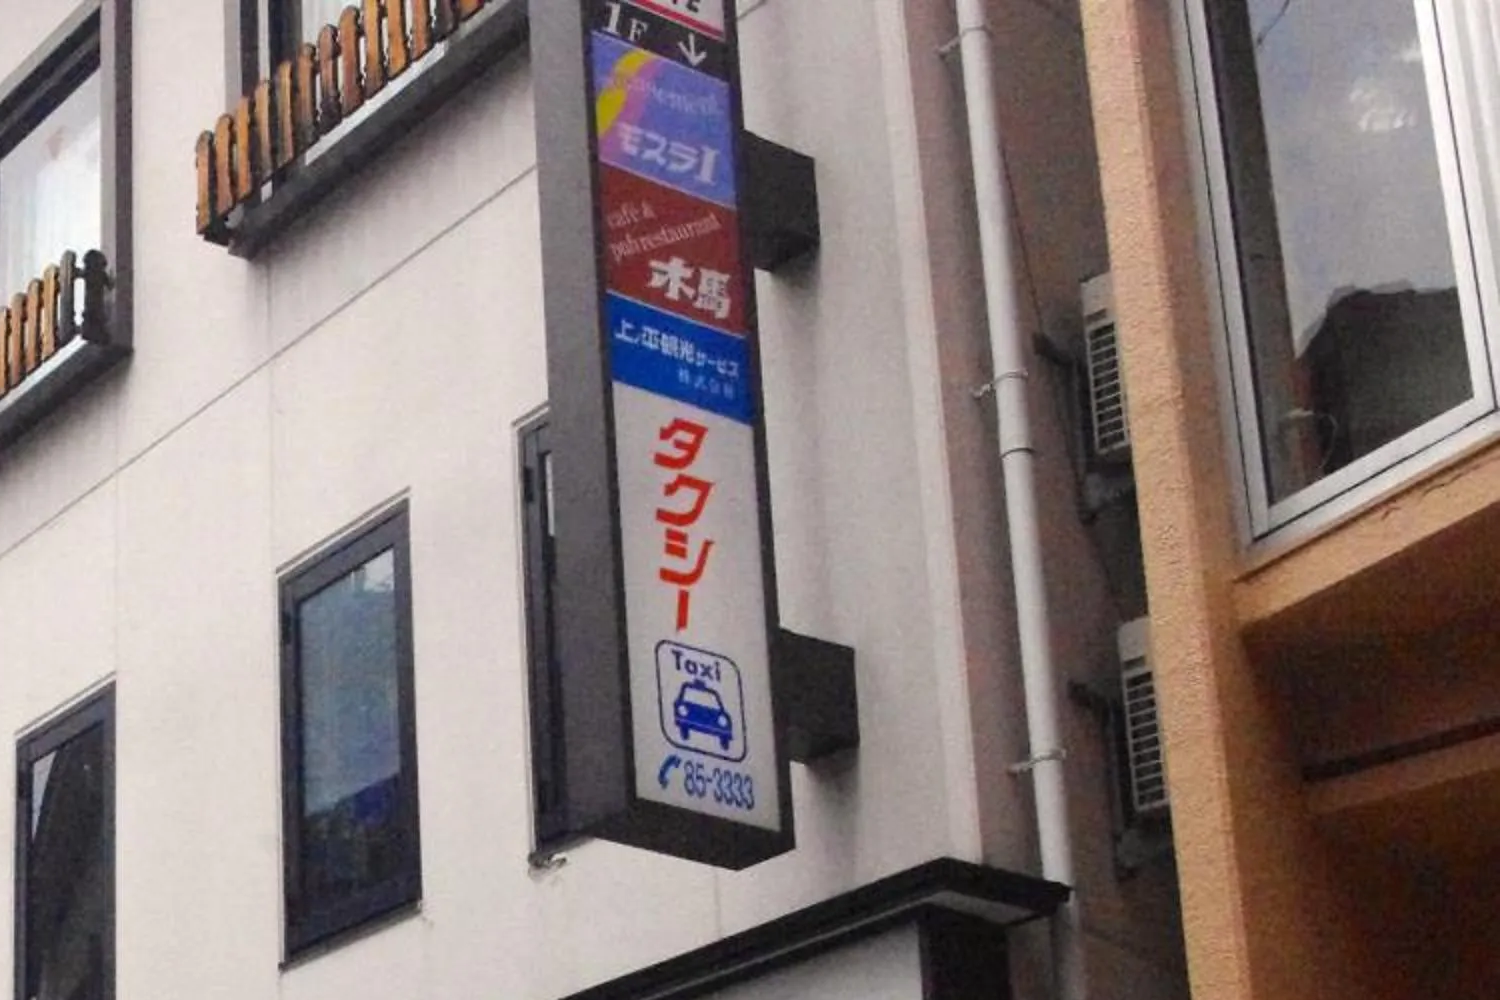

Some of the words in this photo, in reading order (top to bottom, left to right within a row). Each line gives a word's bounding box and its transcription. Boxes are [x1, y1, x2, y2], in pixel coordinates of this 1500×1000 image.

[646, 256, 730, 319] 木馬
[653, 418, 715, 632] タクシー
[671, 649, 721, 683] Taxi
[682, 762, 754, 811] 85-3333
